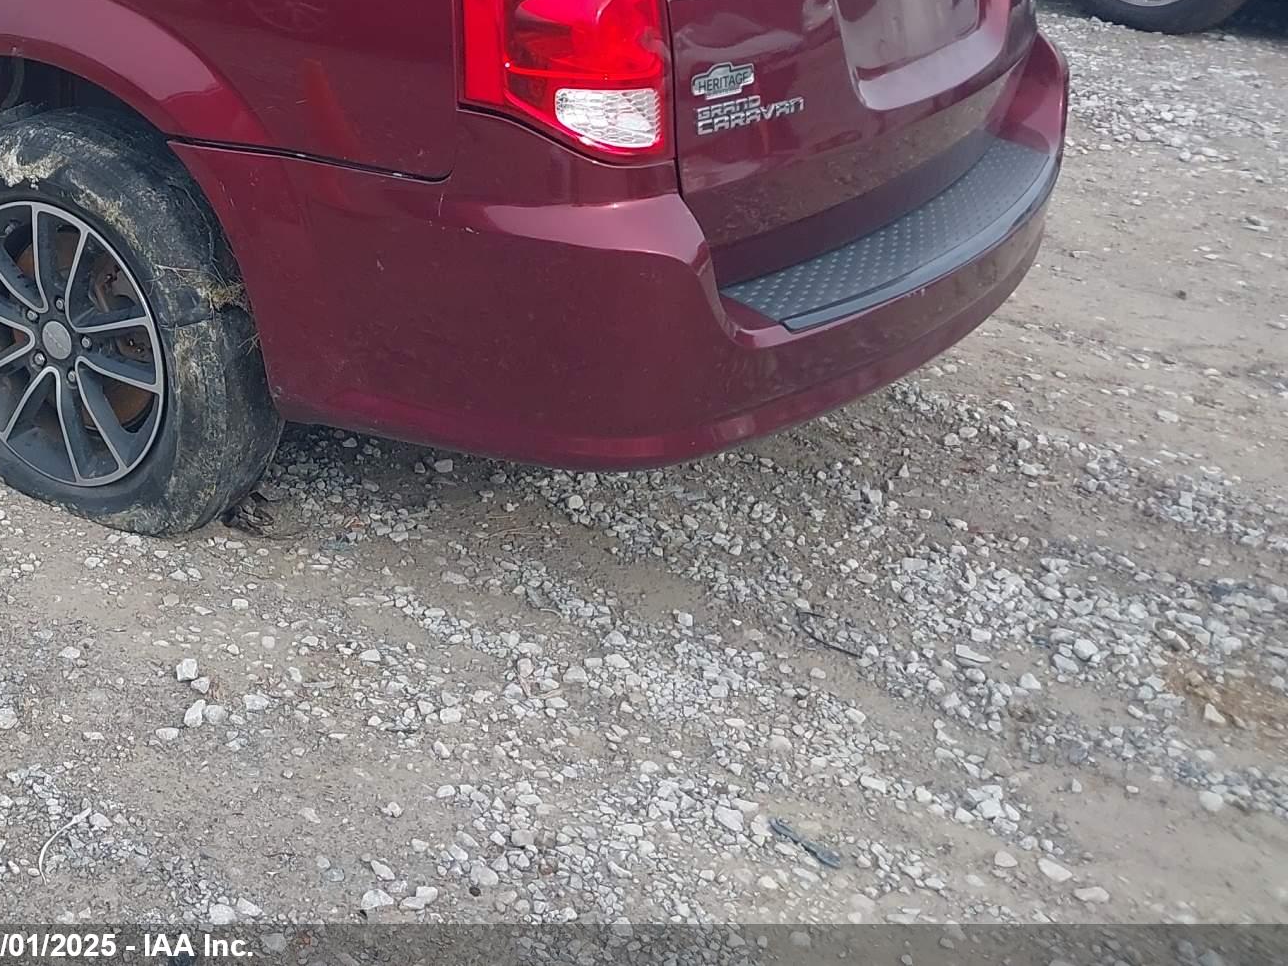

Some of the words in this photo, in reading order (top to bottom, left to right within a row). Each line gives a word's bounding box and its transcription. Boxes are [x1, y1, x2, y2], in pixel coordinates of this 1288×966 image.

[698, 71, 749, 93] HERITAGE
[697, 95, 761, 120] GRAND
[697, 96, 805, 136] CARAVAN
